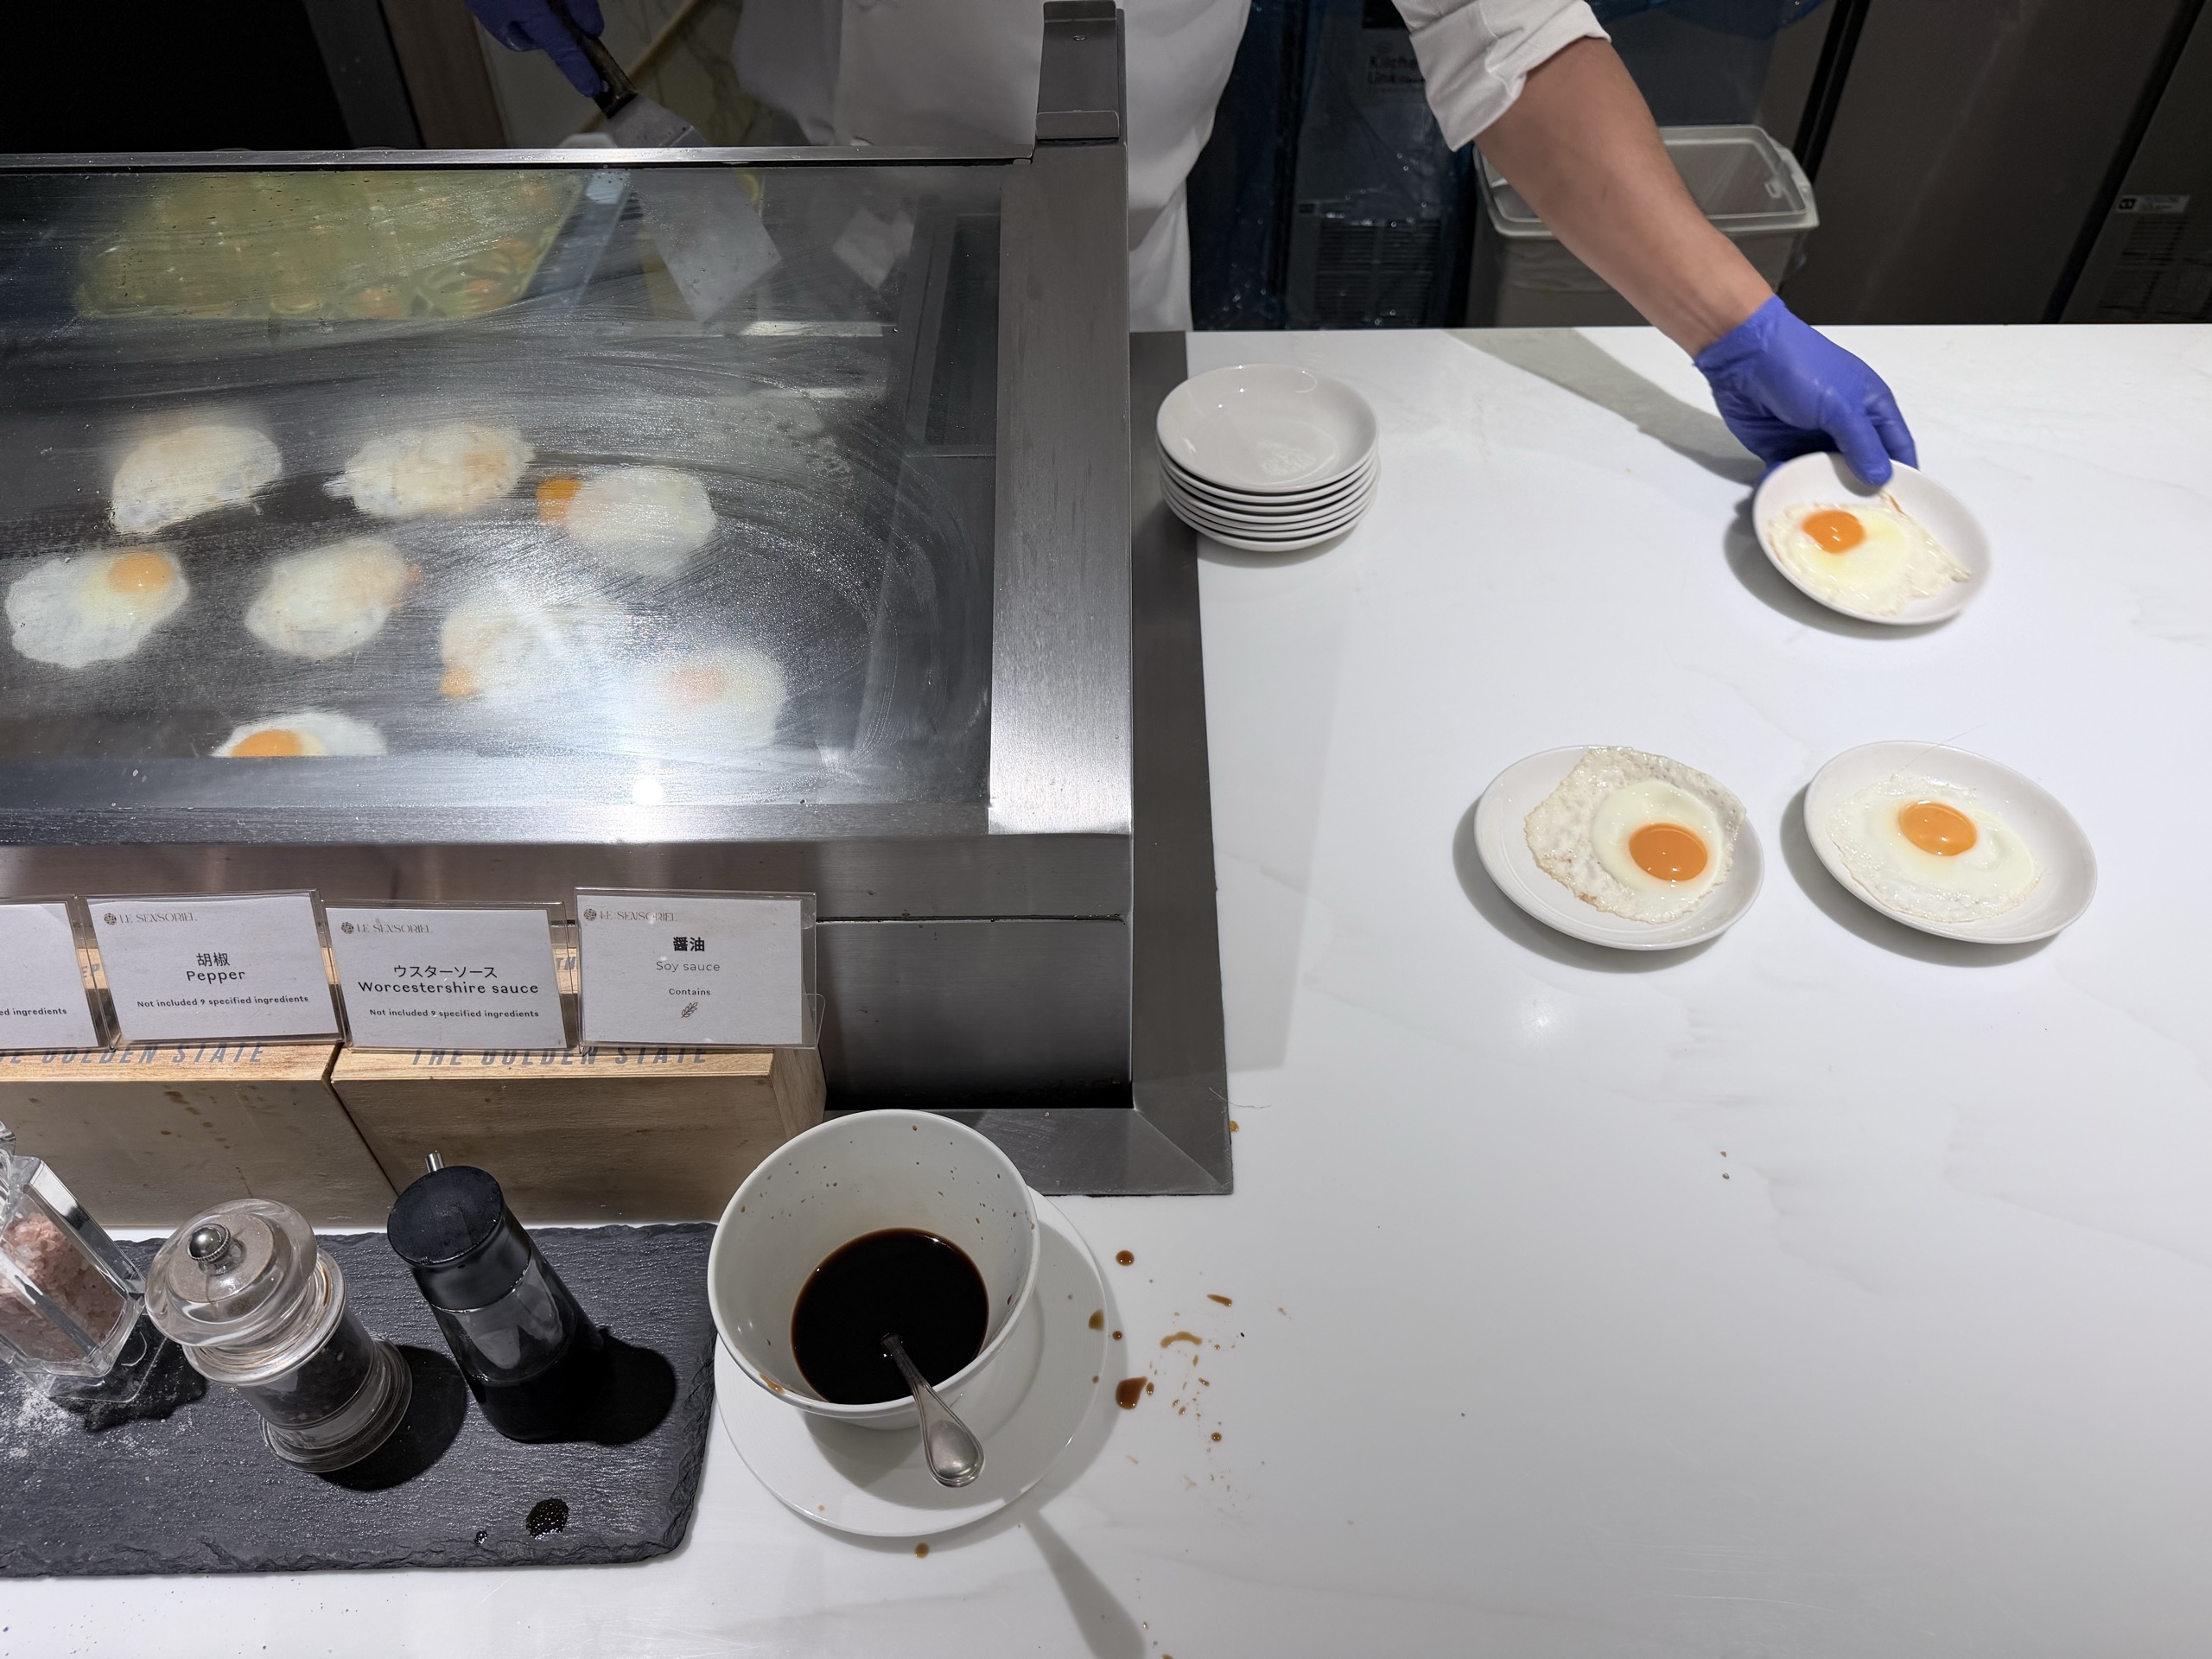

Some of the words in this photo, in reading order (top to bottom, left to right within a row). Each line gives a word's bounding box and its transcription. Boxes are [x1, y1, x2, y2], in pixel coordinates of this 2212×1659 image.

[119, 914, 134, 924] LE
[137, 912, 198, 923] SENSORIEL
[600, 911, 613, 921] LE
[357, 924, 371, 933] LE
[372, 923, 433, 934] SENSORIEL
[672, 936, 705, 952] 醤油
[195, 952, 231, 968] 胡椒
[393, 964, 498, 979] ウスターソース
[656, 961, 679, 973] Soy
[683, 963, 721, 972] sauce
[186, 970, 246, 985] Pepper
[358, 981, 486, 994] Worcestershire
[492, 984, 539, 994] sauce
[668, 988, 711, 996] Contains
[156, 998, 199, 1007] included
[208, 996, 252, 1007] specified
[254, 995, 309, 1005] ingredients
[12, 1007, 67, 1017] ingredients
[389, 1008, 429, 1017] included
[439, 1009, 482, 1019] specified
[484, 1009, 539, 1019] ingredients
